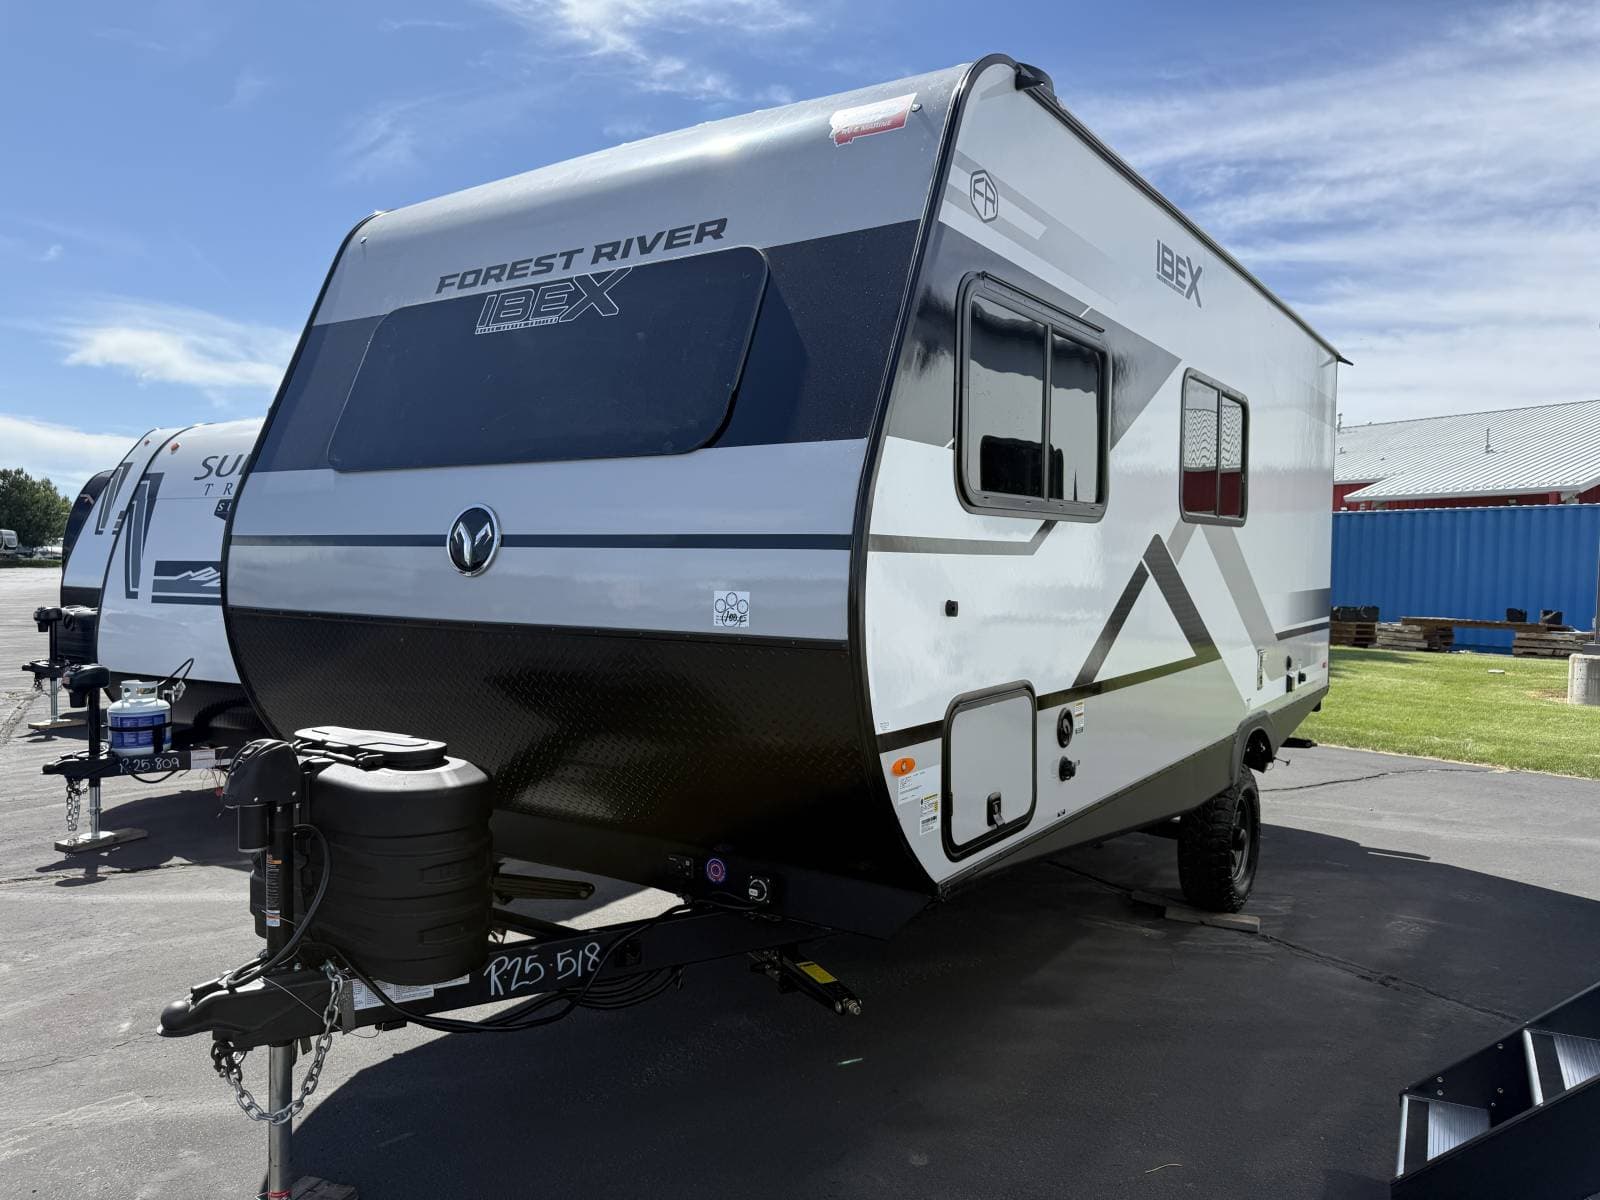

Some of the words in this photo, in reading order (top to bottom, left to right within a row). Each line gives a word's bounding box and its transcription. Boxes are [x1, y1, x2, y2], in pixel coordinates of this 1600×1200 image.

[435, 247, 585, 294] FOREST
[591, 217, 728, 265] RIVER
[1156, 240, 1202, 308] IBEX
[477, 267, 633, 329] IBEX
